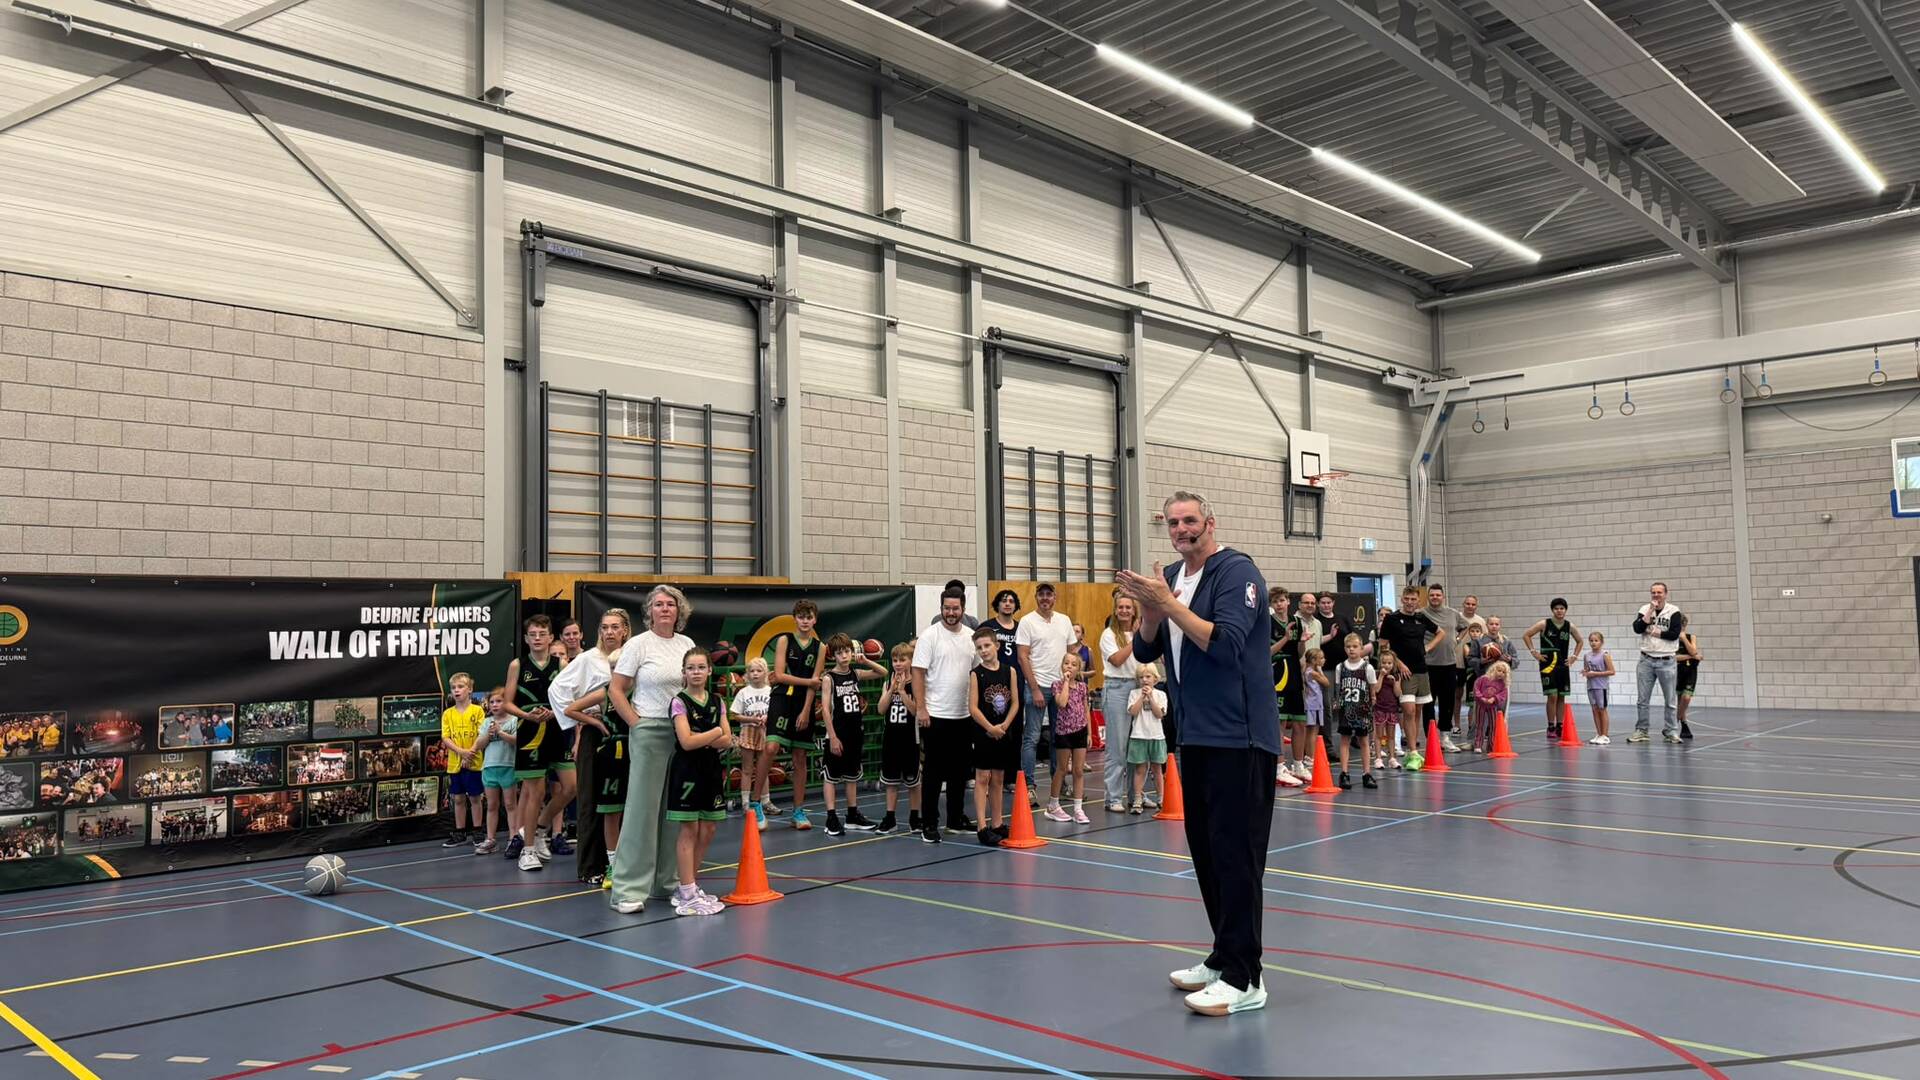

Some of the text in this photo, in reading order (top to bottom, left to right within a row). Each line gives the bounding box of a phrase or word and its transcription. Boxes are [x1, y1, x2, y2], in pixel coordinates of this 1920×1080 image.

[360, 606, 492, 625] DEURNE PIONIERS
[268, 627, 491, 661] WALL OF FRIENDS
[1004, 642, 1013, 656] 5
[842, 695, 860, 713] 82
[1344, 688, 1360, 703] 23
[775, 716, 789, 730] 81
[889, 705, 908, 724] 82
[601, 777, 620, 796] 14
[680, 781, 696, 801] 7
